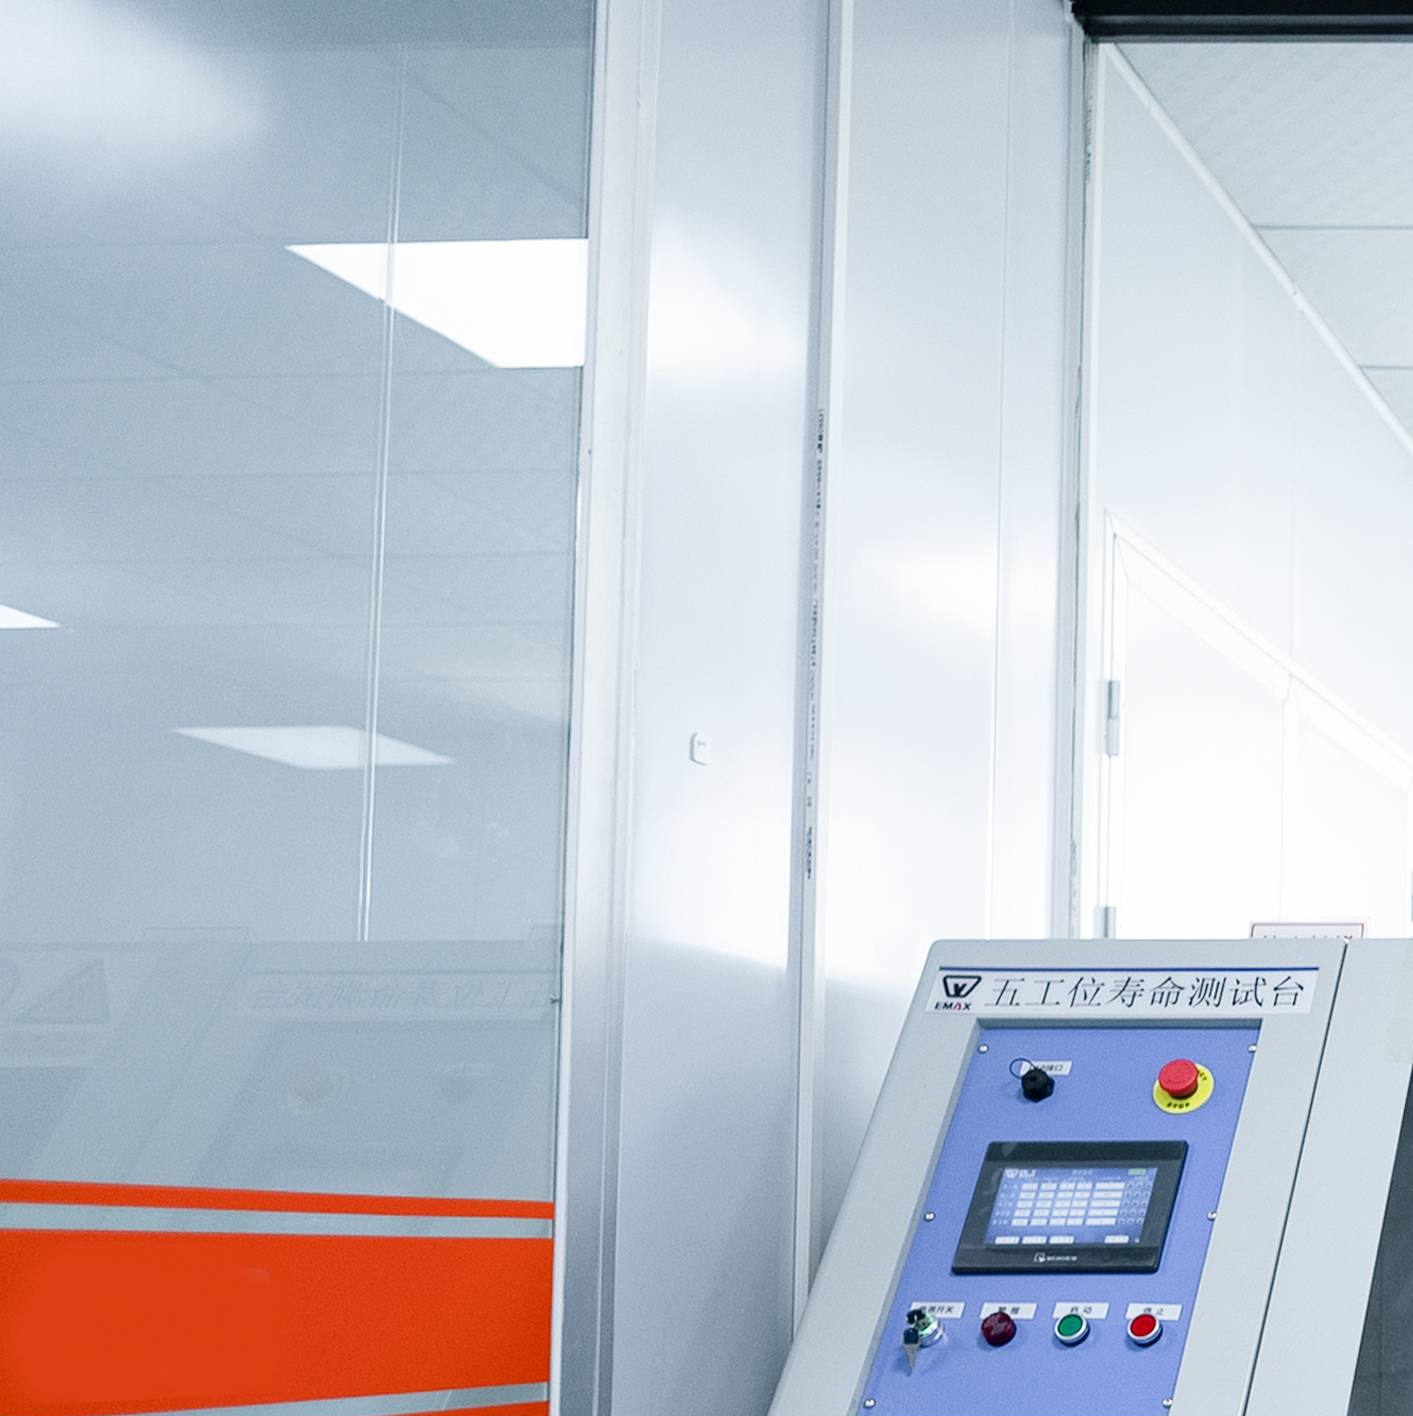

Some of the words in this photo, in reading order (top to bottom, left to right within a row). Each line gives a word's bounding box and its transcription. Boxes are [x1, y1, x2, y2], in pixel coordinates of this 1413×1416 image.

[984, 974, 1305, 1009] 五工位寿命测试台
[934, 1002, 972, 1011] EMAX
